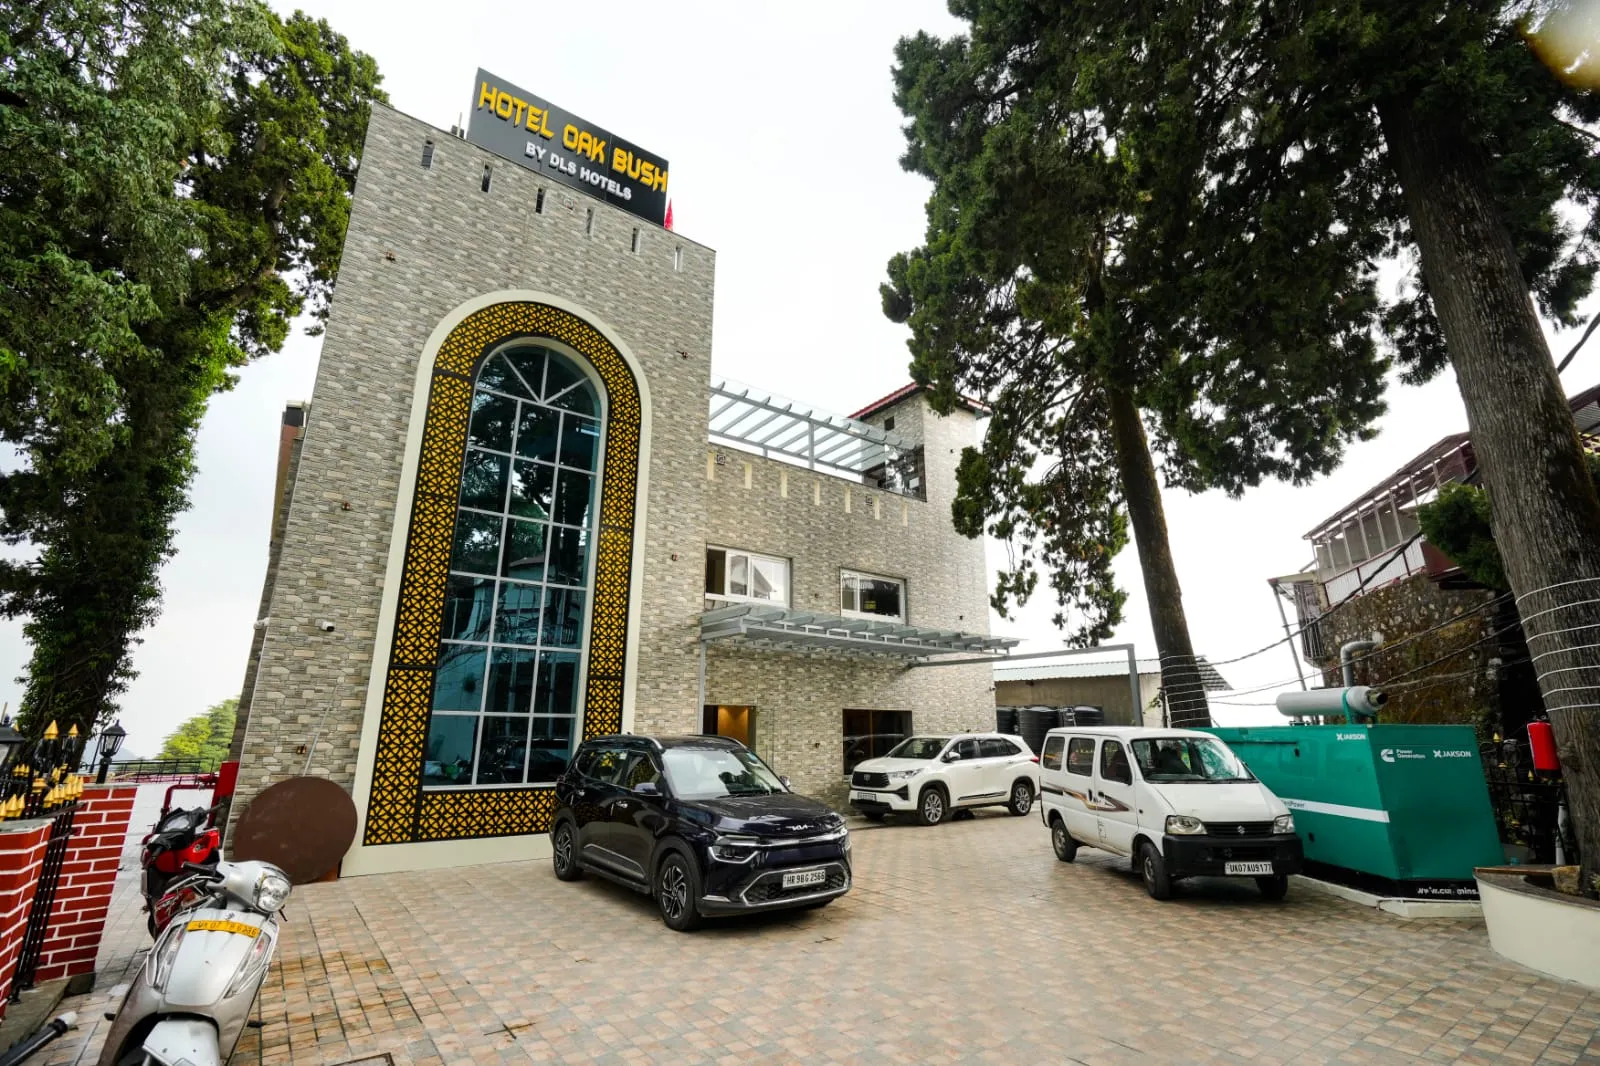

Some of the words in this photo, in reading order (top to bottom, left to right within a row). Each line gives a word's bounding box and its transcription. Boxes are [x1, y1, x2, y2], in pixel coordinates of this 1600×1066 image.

[479, 81, 554, 139] HOTEL
[563, 123, 606, 164] OAK
[612, 147, 668, 192] BUSH
[525, 141, 547, 160] BY
[549, 153, 577, 175] DLS
[579, 166, 632, 201] HOTELS
